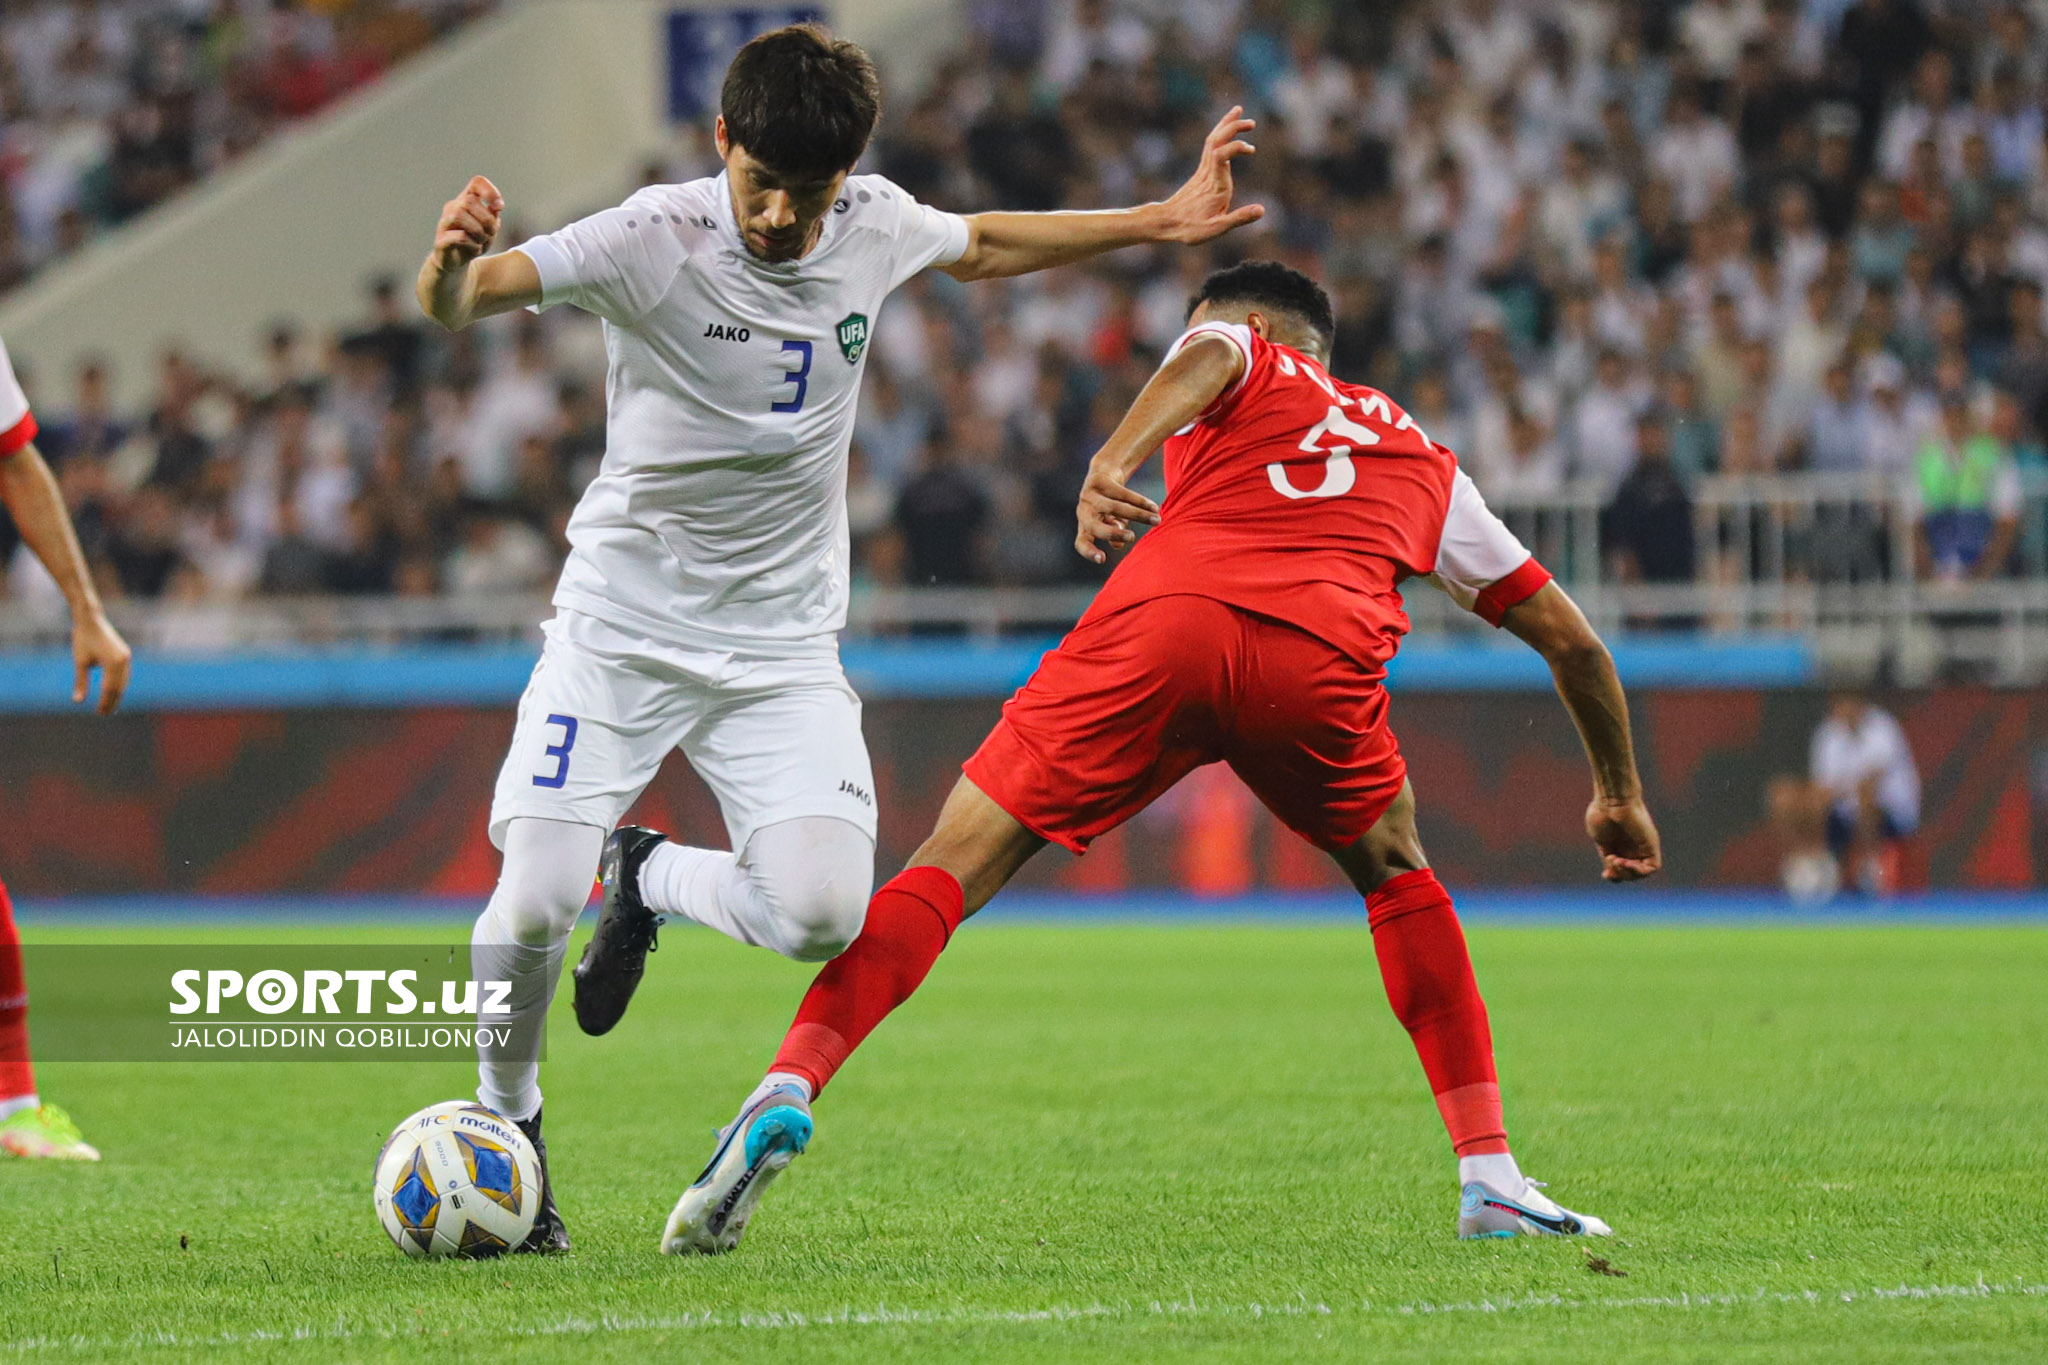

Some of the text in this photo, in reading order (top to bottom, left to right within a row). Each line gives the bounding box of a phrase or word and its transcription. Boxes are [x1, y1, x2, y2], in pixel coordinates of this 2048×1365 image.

[703, 323, 750, 343] JAKO
[840, 321, 865, 345] UFA
[771, 340, 813, 413] 3
[533, 713, 578, 789] 3
[838, 779, 872, 807] JAKO
[460, 1116, 521, 1150] molten
